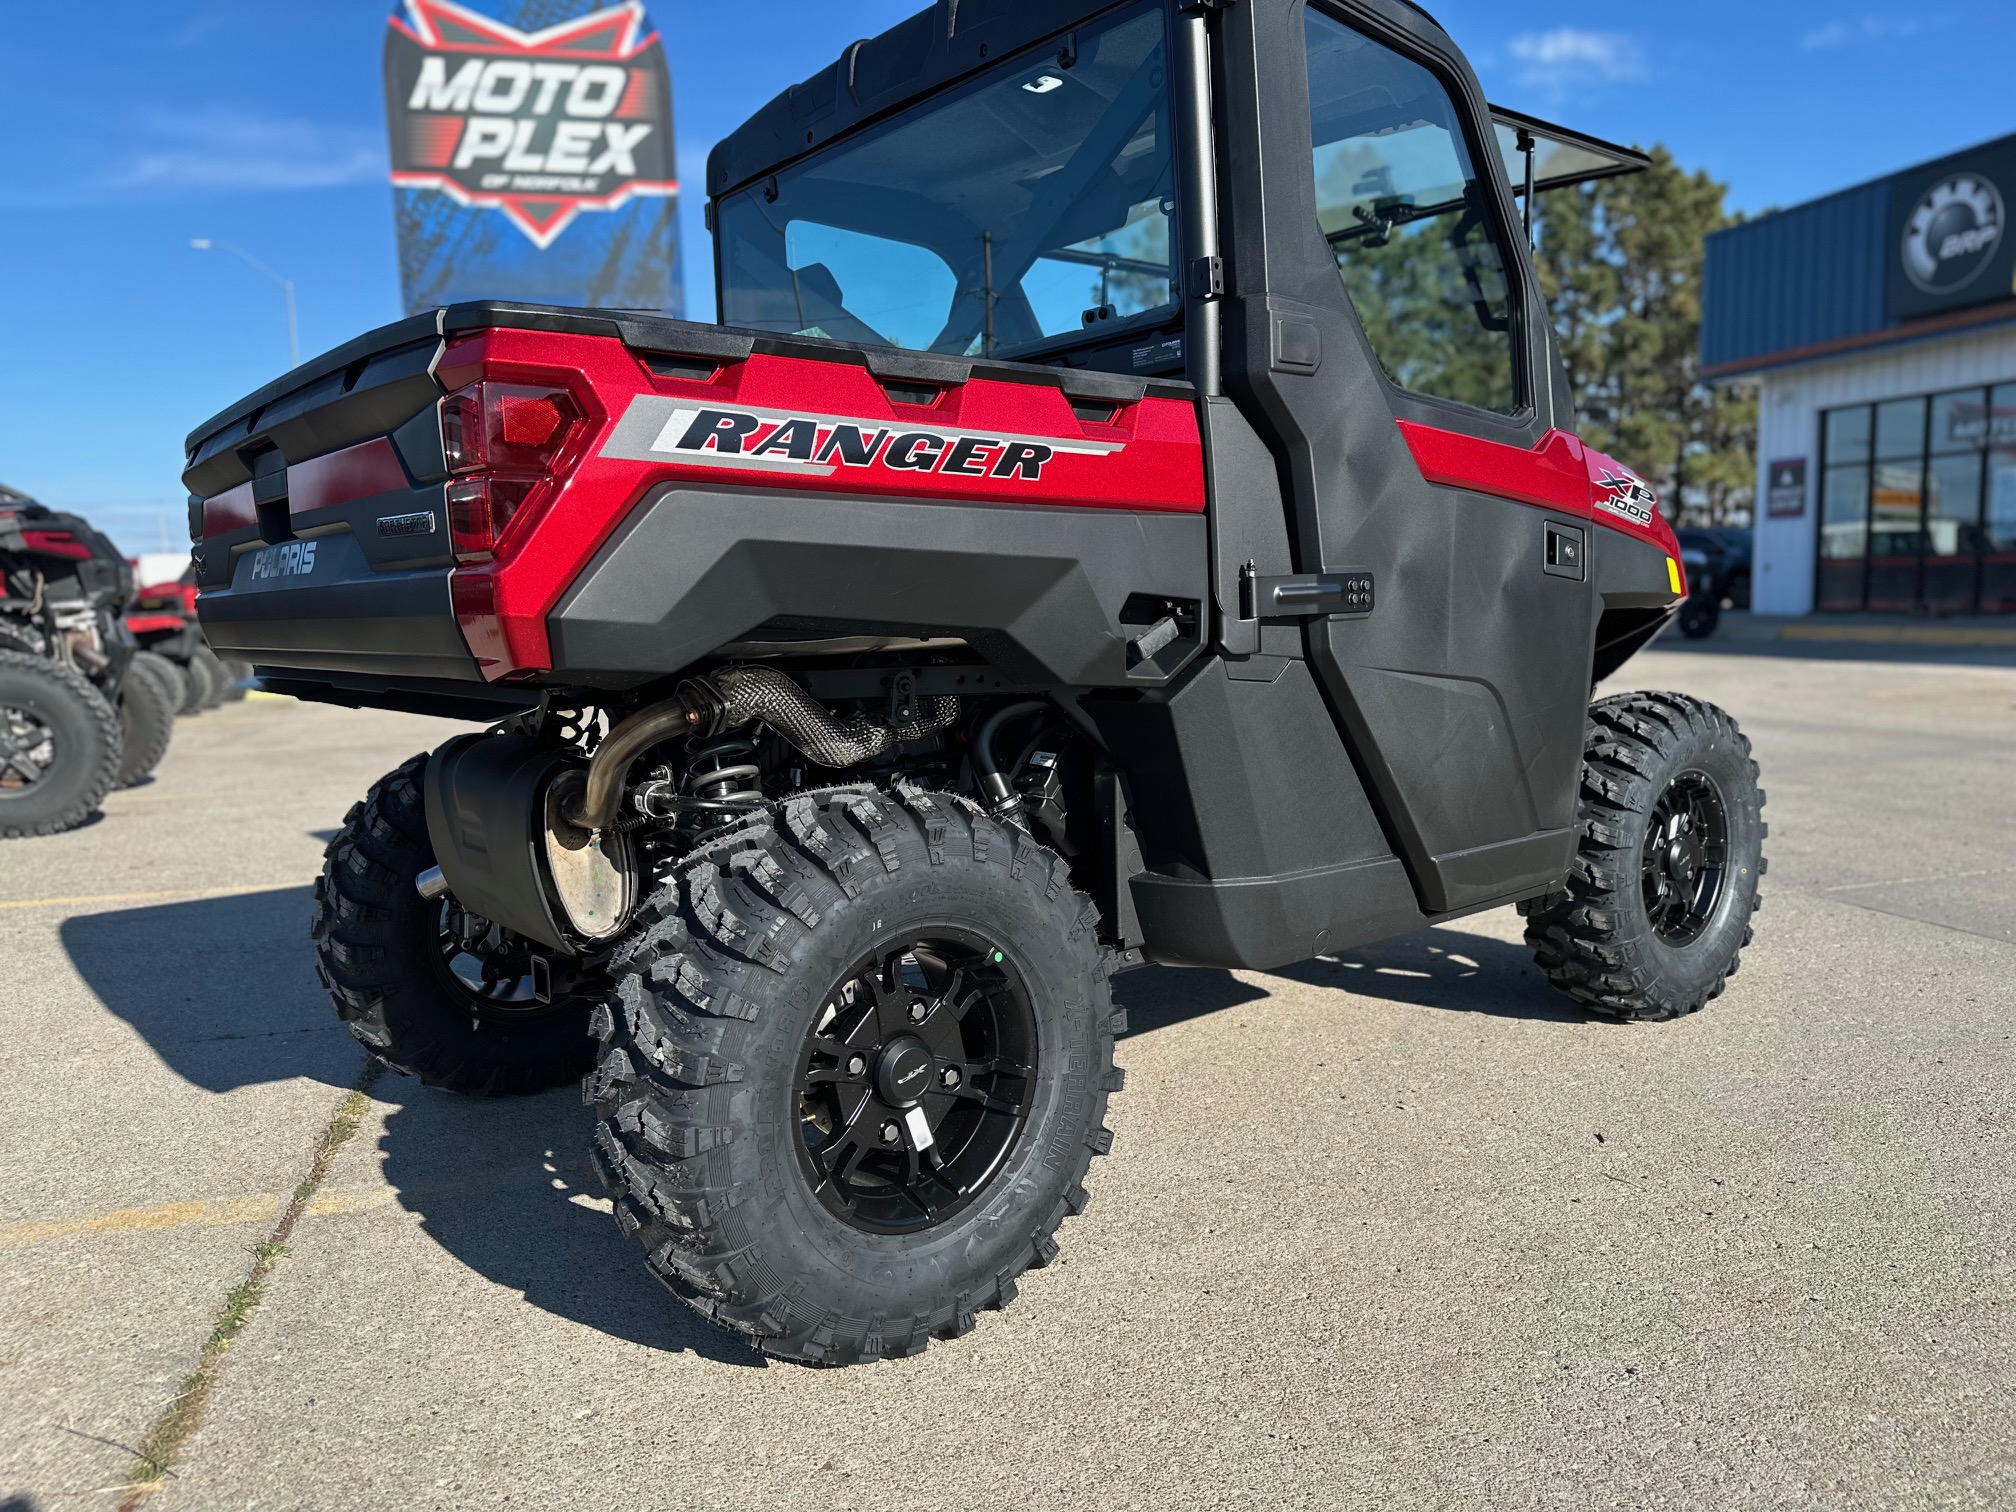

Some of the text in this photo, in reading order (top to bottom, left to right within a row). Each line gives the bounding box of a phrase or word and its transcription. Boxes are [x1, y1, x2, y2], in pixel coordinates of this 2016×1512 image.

[407, 56, 627, 118] MOTO
[453, 117, 653, 175] PLEX
[480, 173, 511, 190] OF
[1939, 225, 1997, 260] BRP
[673, 408, 1053, 481] RANGER
[1596, 468, 1656, 504] XP
[1608, 495, 1652, 524] 1000
[252, 541, 317, 580] POLARIS
[1043, 996, 1089, 1175] X-TERRAIN
